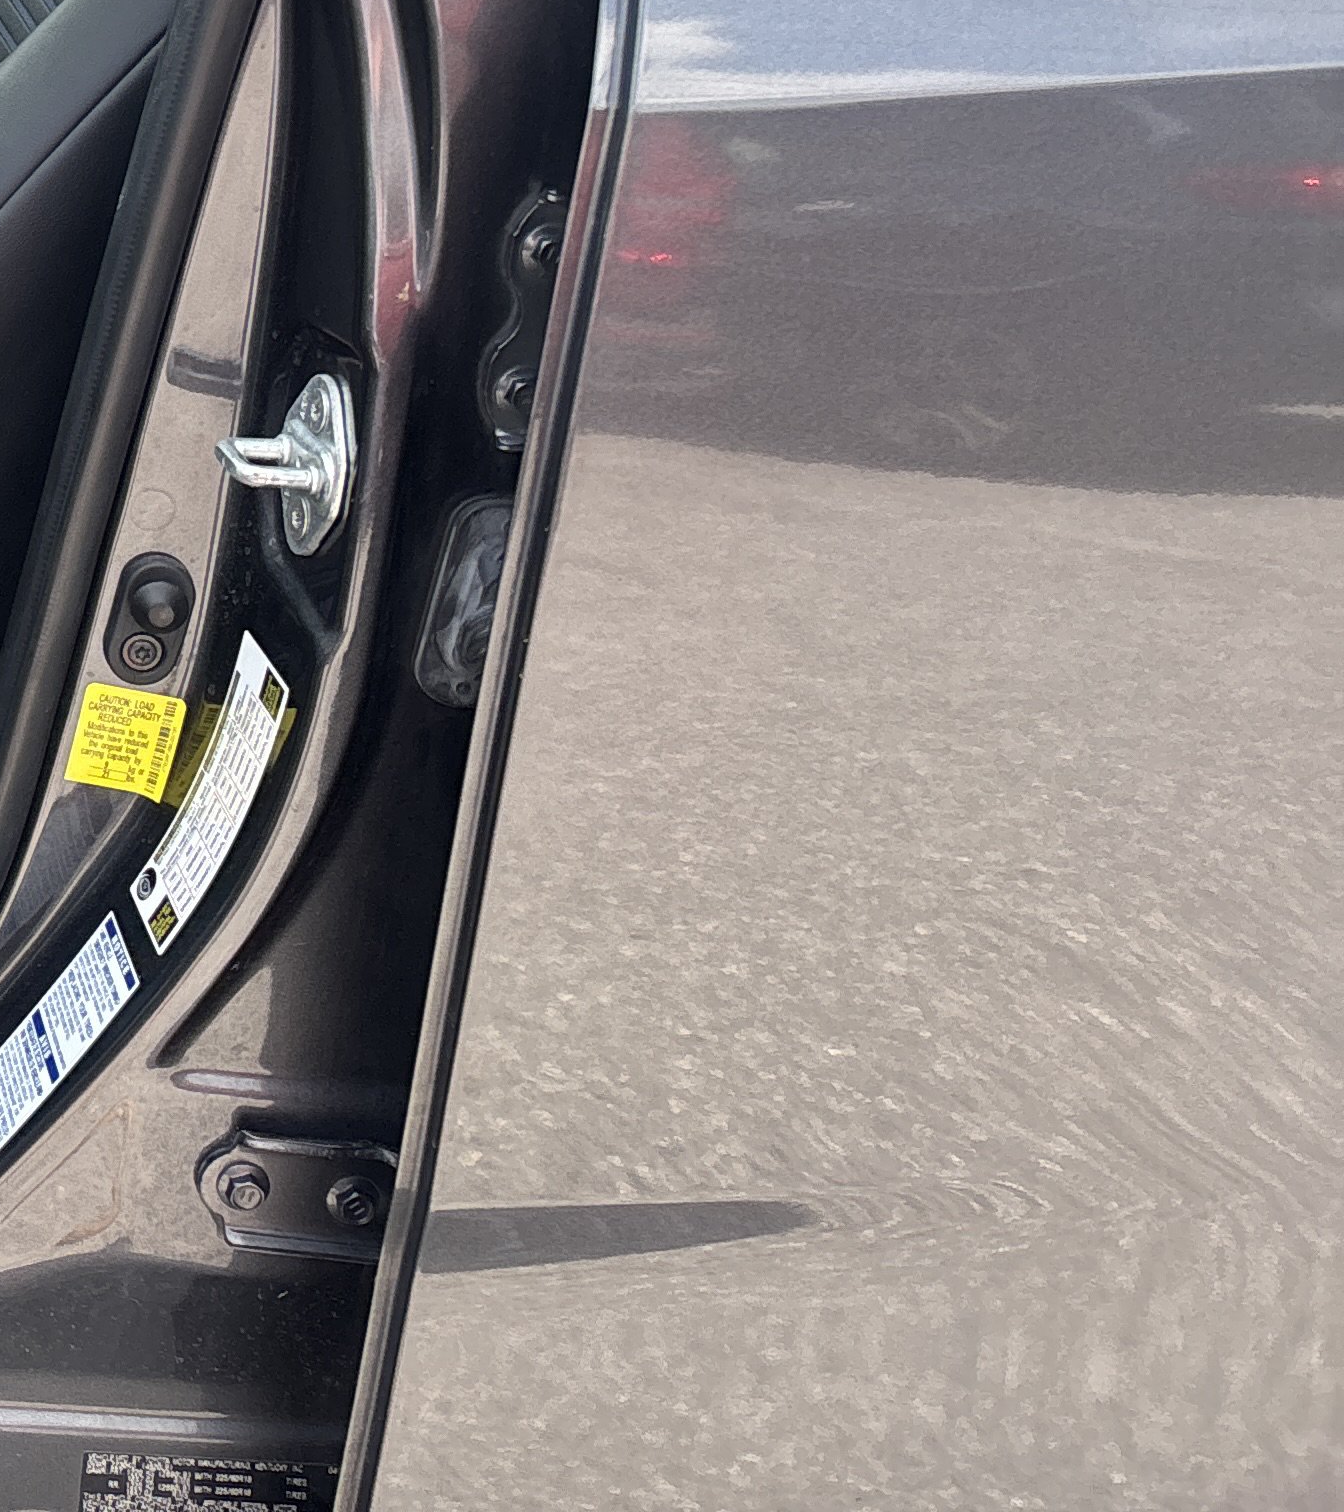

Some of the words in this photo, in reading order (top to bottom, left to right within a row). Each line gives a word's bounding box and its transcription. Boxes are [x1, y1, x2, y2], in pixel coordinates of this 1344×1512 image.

[88, 701, 123, 715] CARRYING
[127, 709, 161, 722] CAPACITY
[135, 700, 155, 711] LOAD
[98, 713, 132, 726] REDUCED
[124, 738, 150, 749] reduced
[81, 748, 104, 760] carrying
[107, 752, 131, 764] capacity
[125, 746, 139, 755] load
[110, 933, 130, 977] NOTICE
